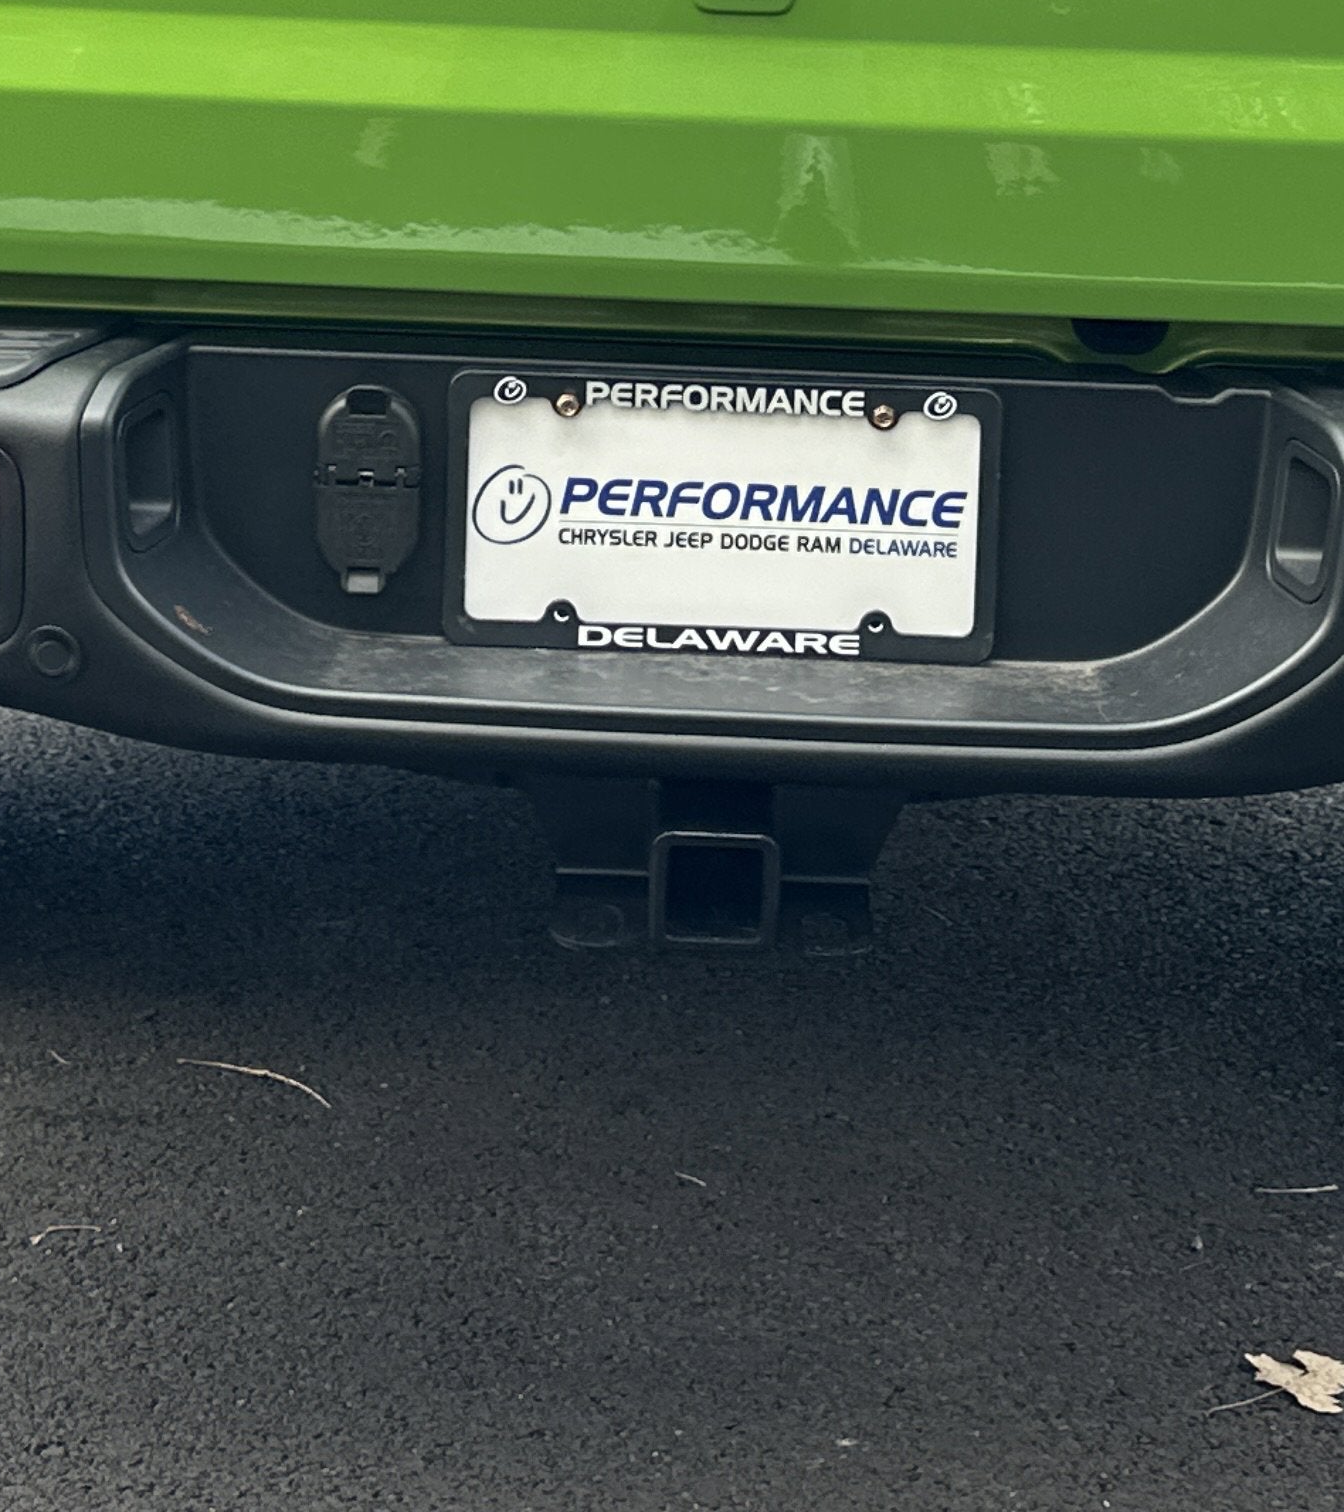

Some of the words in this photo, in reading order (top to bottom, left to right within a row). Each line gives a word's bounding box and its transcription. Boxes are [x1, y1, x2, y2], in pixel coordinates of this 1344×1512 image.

[585, 381, 866, 417] PERFORMANCE
[559, 476, 968, 529] PERFORMANCE
[558, 527, 658, 548] CHRYSLER
[663, 530, 713, 550] JEEP
[720, 532, 789, 552] DODGE
[797, 535, 841, 554] RAM
[849, 537, 958, 558] DELAWARE
[577, 624, 861, 656] DELAWARE
